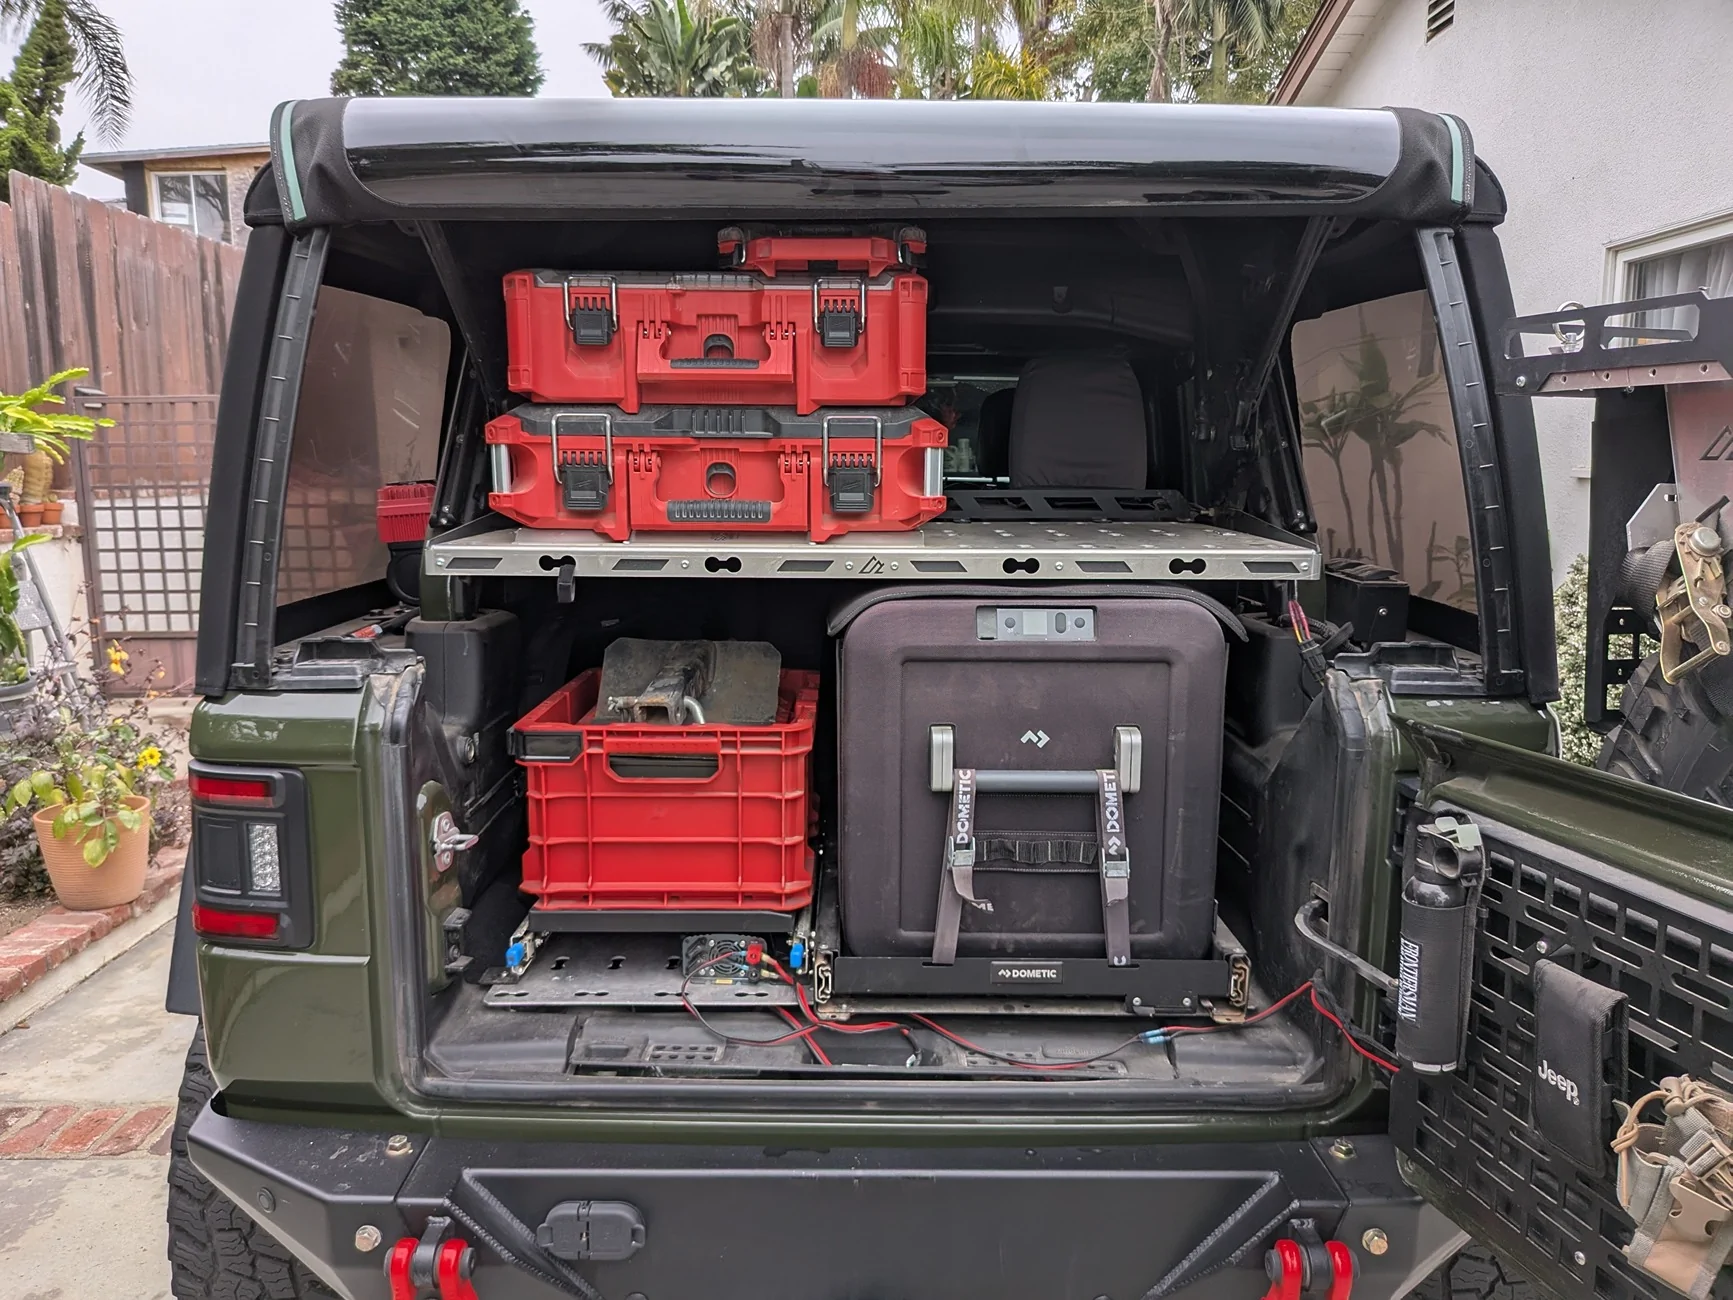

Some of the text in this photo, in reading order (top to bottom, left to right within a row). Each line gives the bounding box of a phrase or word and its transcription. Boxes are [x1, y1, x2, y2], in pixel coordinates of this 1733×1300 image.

[956, 770, 972, 844] DOMETIC
[1012, 969, 1057, 978] DOMETIC
[1400, 938, 1419, 1021] FRONTIERSMAN
